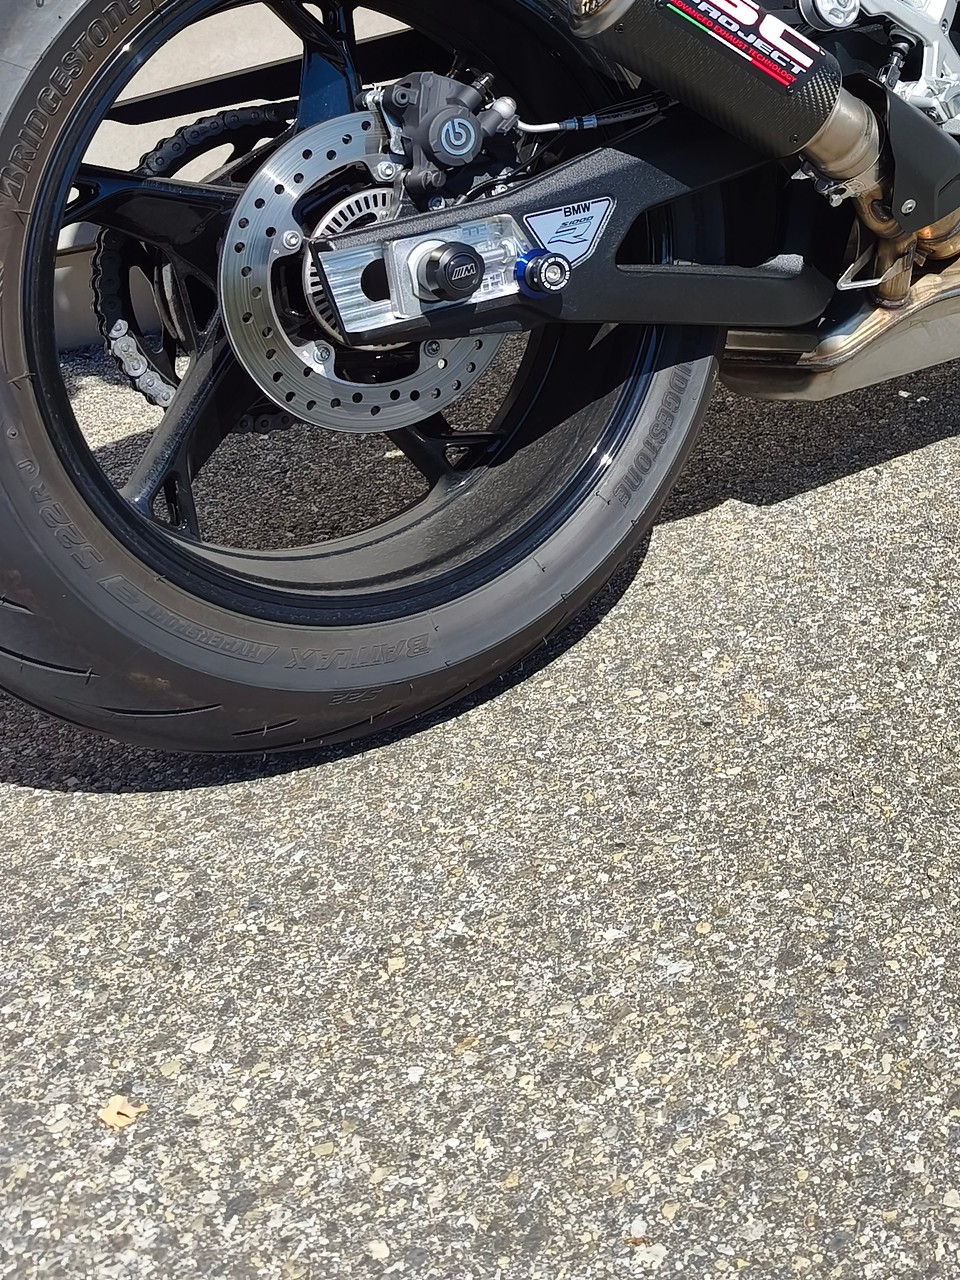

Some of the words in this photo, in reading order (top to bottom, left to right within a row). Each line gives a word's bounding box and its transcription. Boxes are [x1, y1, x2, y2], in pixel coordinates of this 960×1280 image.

[713, 25, 748, 51] EXHAUST
[747, 47, 797, 83] TECHNOLOGY
[561, 215, 594, 226] S1000
[563, 202, 591, 218] BMW
[613, 360, 696, 509] IDGESTONE
[284, 632, 433, 671] BATTLAX
